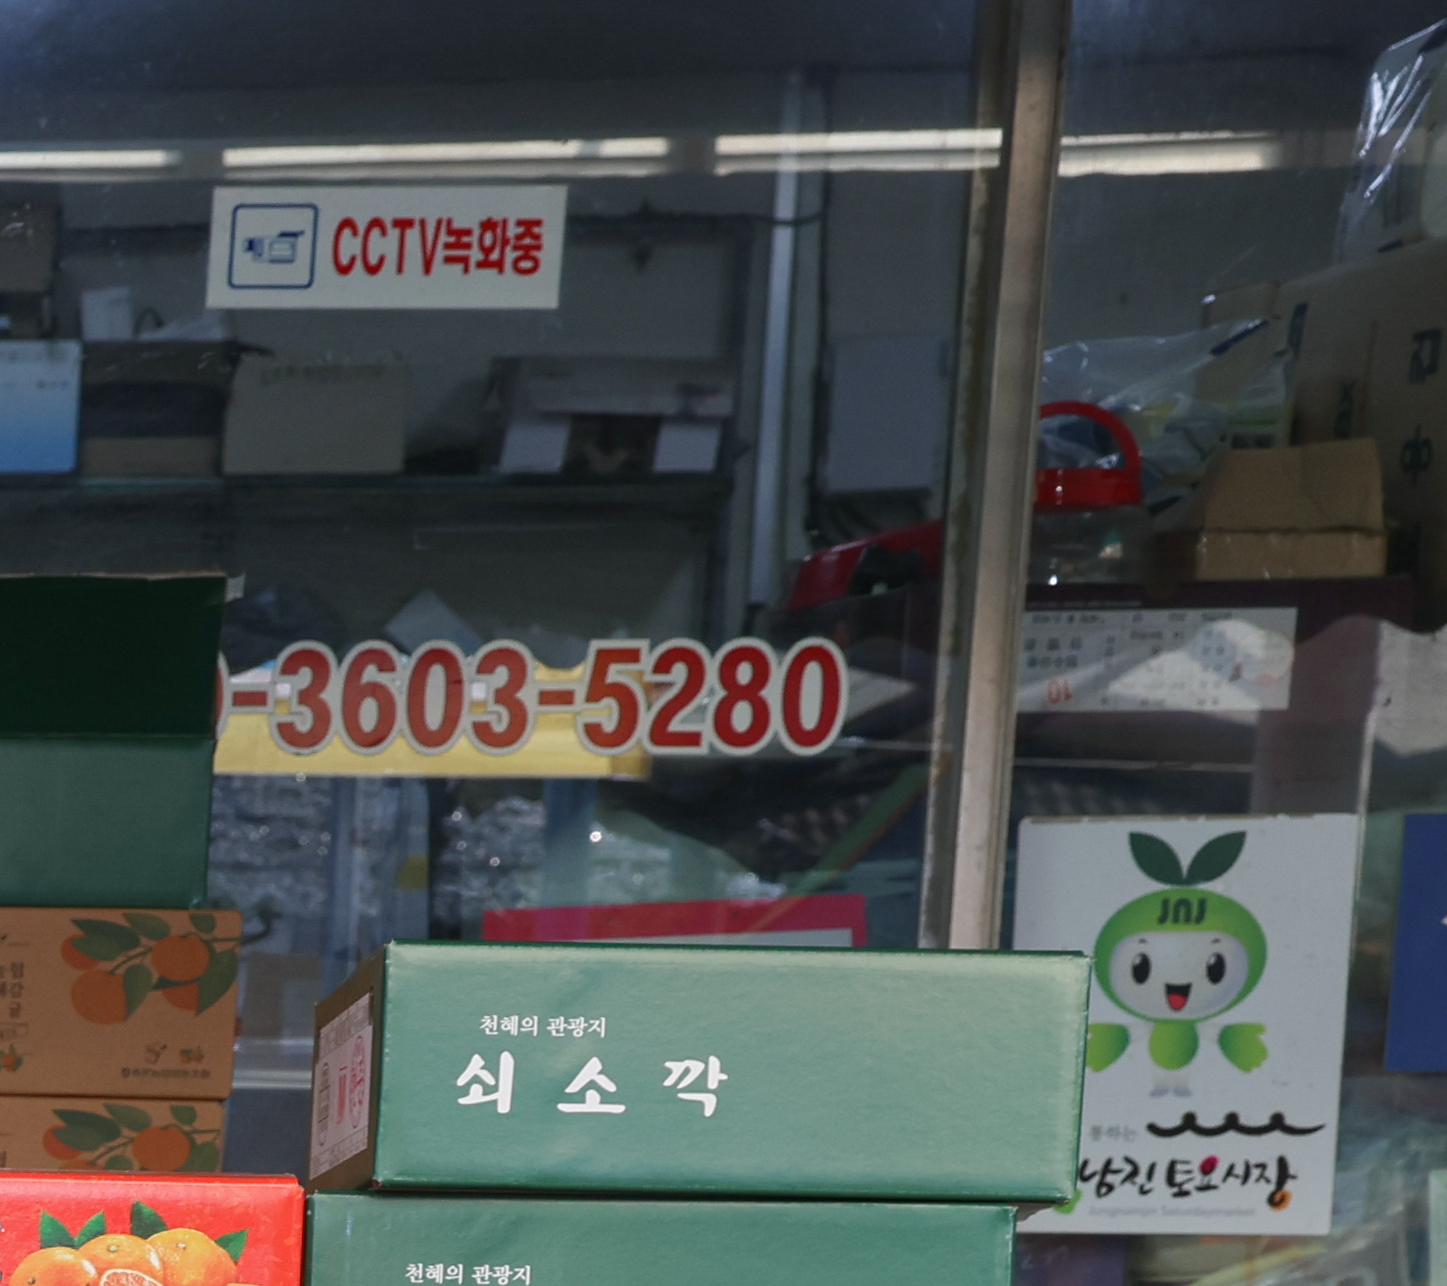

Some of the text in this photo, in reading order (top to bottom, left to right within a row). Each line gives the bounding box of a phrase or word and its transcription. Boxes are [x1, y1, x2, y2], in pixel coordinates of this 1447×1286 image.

[332, 216, 544, 276] CCTV녹화중
[480, 1015, 607, 1038] 천혜의 관광지
[1166, 1155, 1298, 1209] 토요시장
[405, 1263, 531, 1286] 천혜의 관광지
